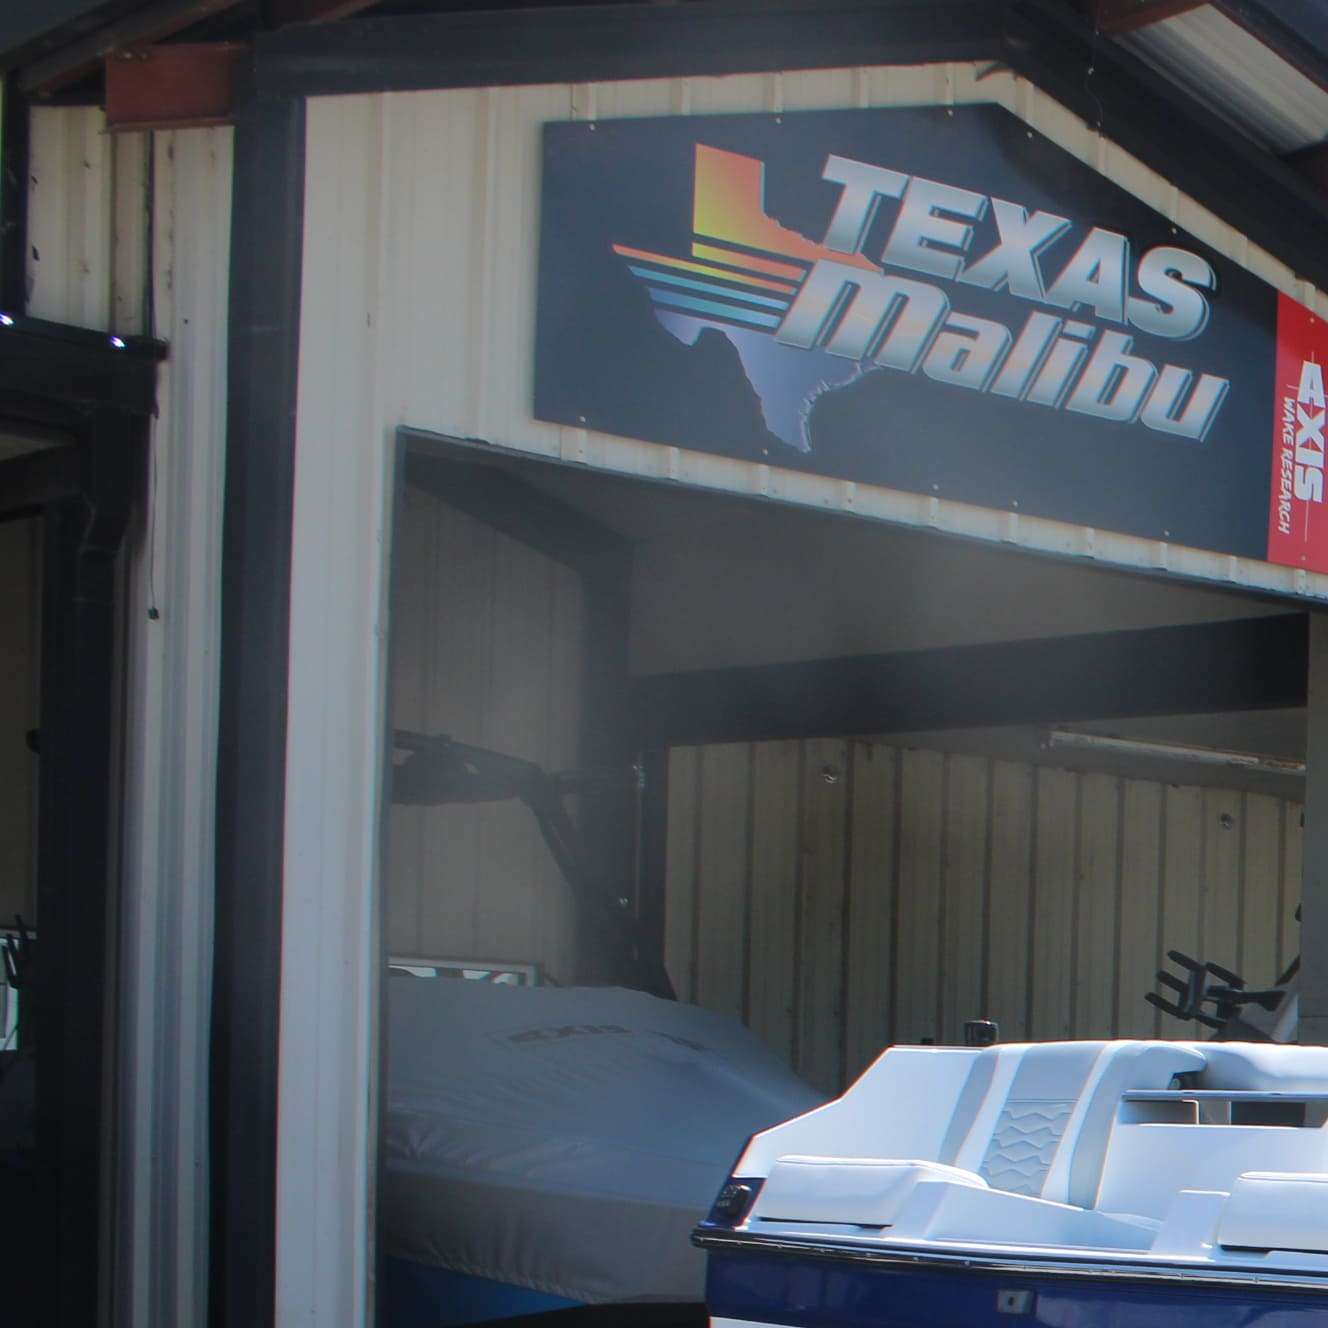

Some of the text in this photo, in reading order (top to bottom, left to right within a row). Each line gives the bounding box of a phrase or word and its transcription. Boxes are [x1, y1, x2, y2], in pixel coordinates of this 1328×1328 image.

[821, 154, 1217, 341] TEXAS
[774, 258, 1231, 443] Malibu
[1293, 360, 1326, 503] AXIS
[1278, 396, 1296, 534] WAKE RESEARCH
